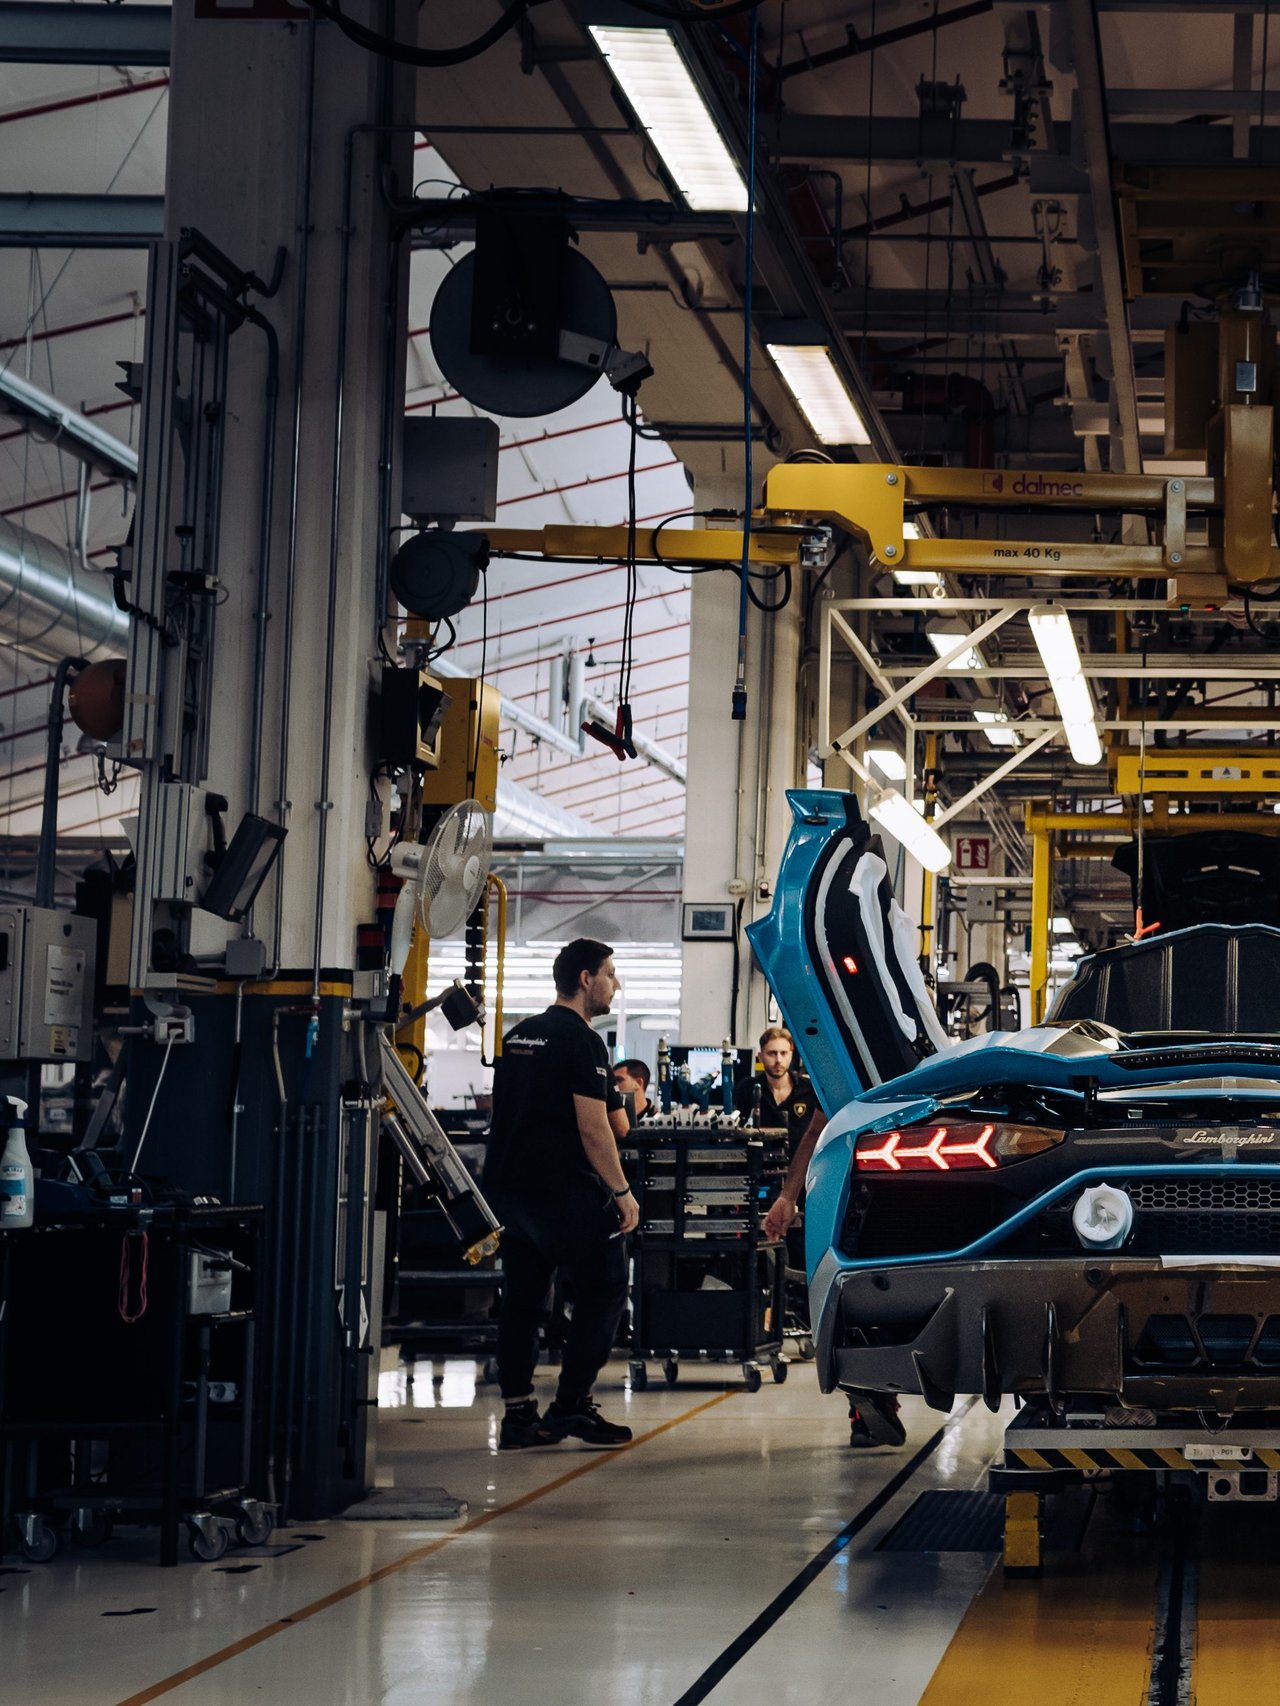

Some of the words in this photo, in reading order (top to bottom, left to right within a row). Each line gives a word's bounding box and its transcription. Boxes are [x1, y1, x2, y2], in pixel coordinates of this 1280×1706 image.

[1012, 473, 1083, 497] dalmec
[994, 549, 1019, 558] max
[1023, 548, 1040, 559] 40
[1045, 548, 1061, 561] Kg
[1183, 1130, 1275, 1147] Lamborghini
